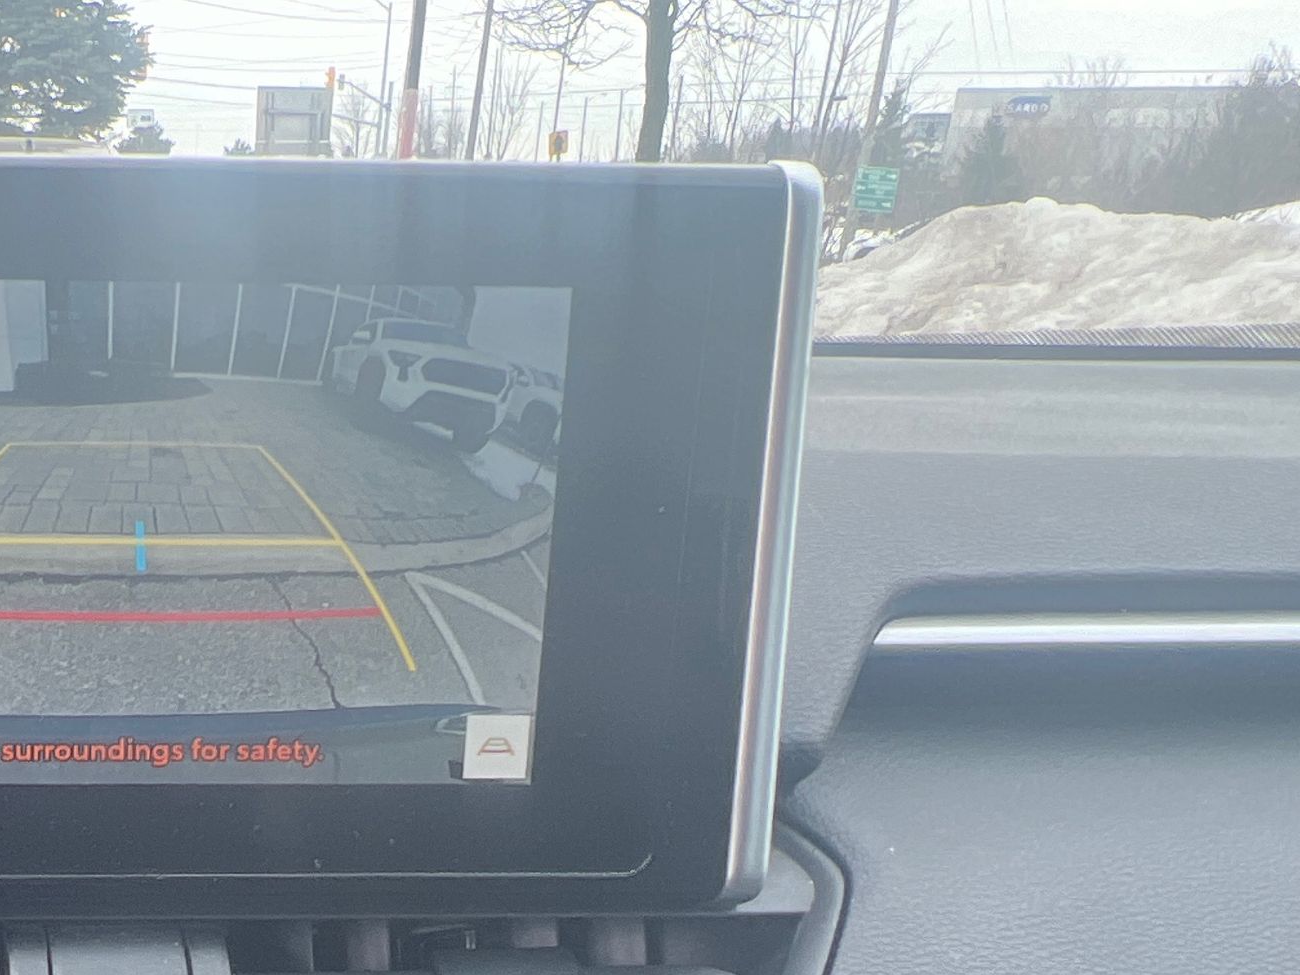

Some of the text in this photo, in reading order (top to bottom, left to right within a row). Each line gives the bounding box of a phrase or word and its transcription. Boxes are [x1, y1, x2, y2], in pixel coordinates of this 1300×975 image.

[1, 738, 184, 766] surroundings
[191, 737, 229, 761] for
[236, 738, 323, 767] safety.
